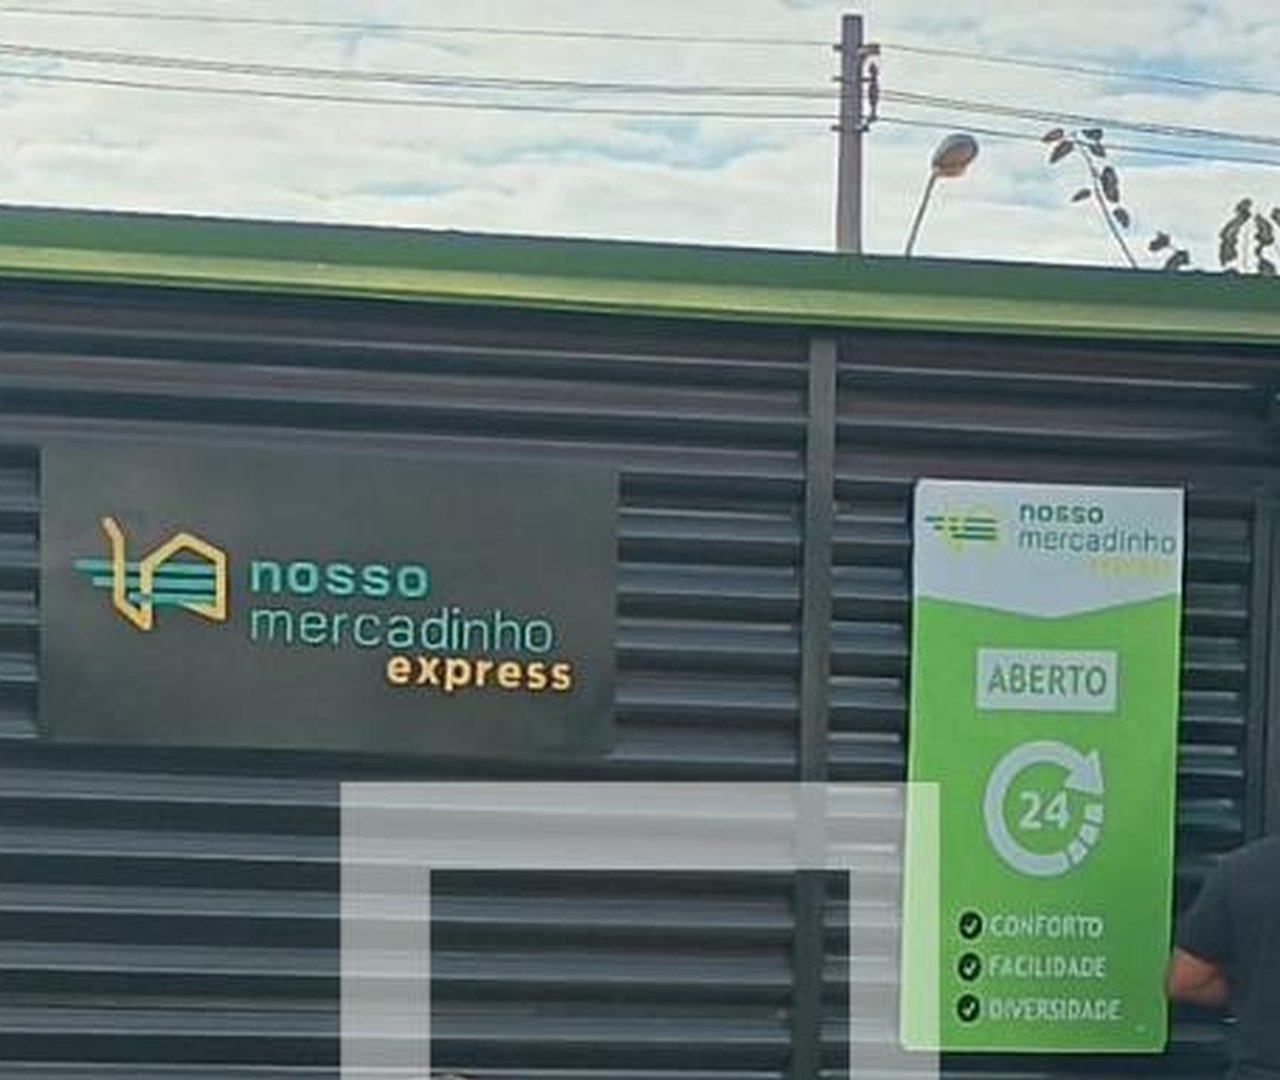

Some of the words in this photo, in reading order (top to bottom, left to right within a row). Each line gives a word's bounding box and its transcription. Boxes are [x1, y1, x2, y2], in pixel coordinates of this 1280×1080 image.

[1019, 503, 1104, 524] nosso
[1019, 526, 1176, 555] mercadinho
[250, 559, 428, 598] nosso
[250, 606, 553, 653] mercadinho
[387, 655, 572, 692] express
[987, 664, 1107, 697] ABERTO
[1019, 791, 1069, 830] 24
[990, 914, 1103, 937] CONFORTO
[989, 955, 1106, 979] FACILIDADE
[988, 999, 1122, 1021] DIVERSIDADE
